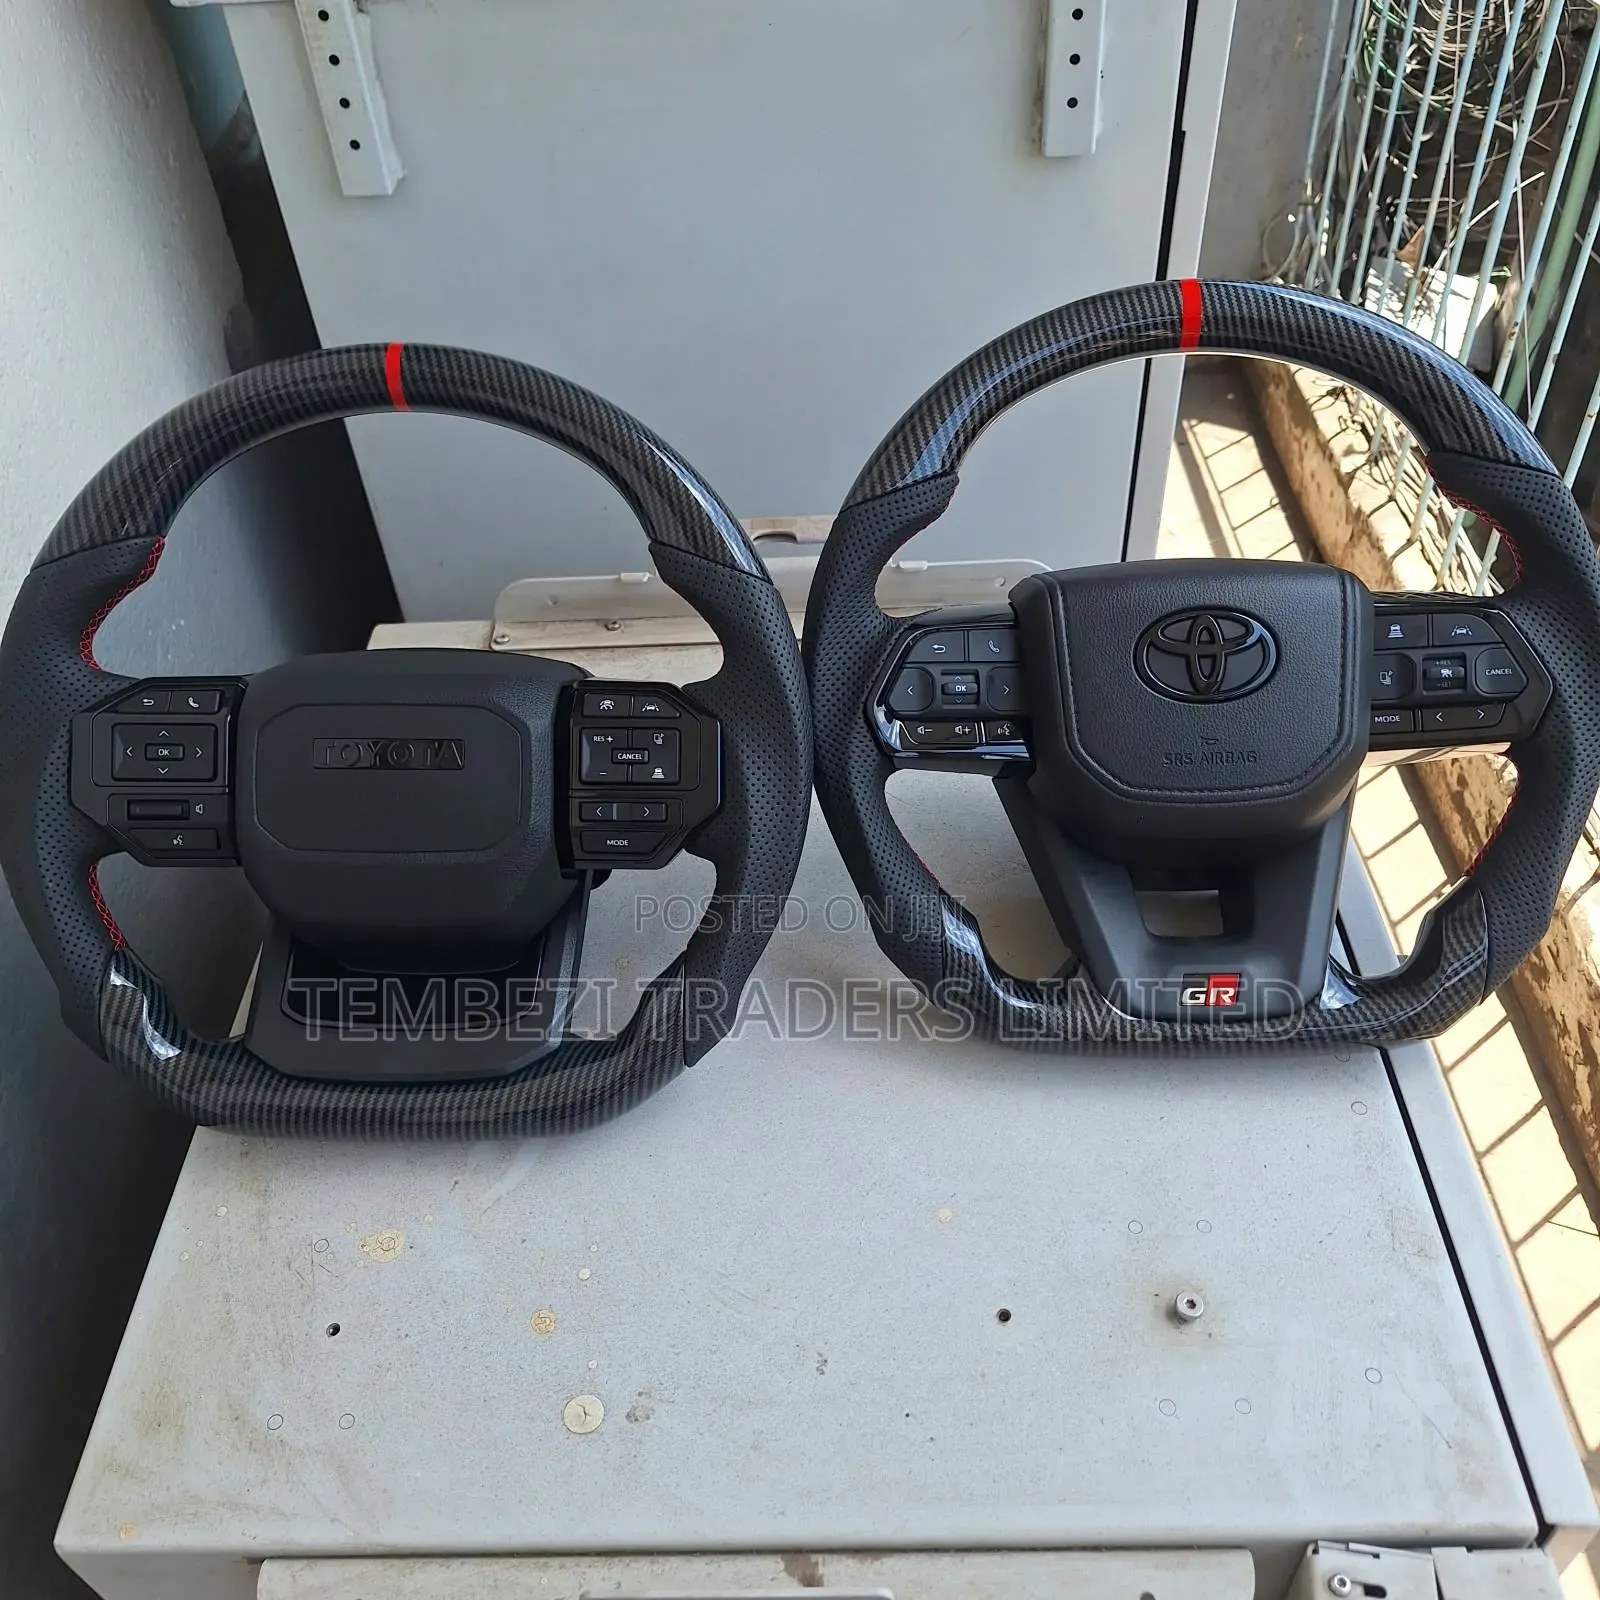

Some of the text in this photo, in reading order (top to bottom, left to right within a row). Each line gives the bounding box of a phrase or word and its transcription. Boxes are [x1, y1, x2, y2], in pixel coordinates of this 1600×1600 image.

[1485, 668, 1513, 676] CANCEL
[955, 684, 967, 692] OK
[1374, 715, 1401, 723] MODE
[158, 748, 170, 757] OK
[320, 739, 463, 768] TOYOTA
[617, 752, 643, 760] CANCEL
[1162, 750, 1257, 768] SRS AIRBAG
[1181, 987, 1235, 1006] GR
